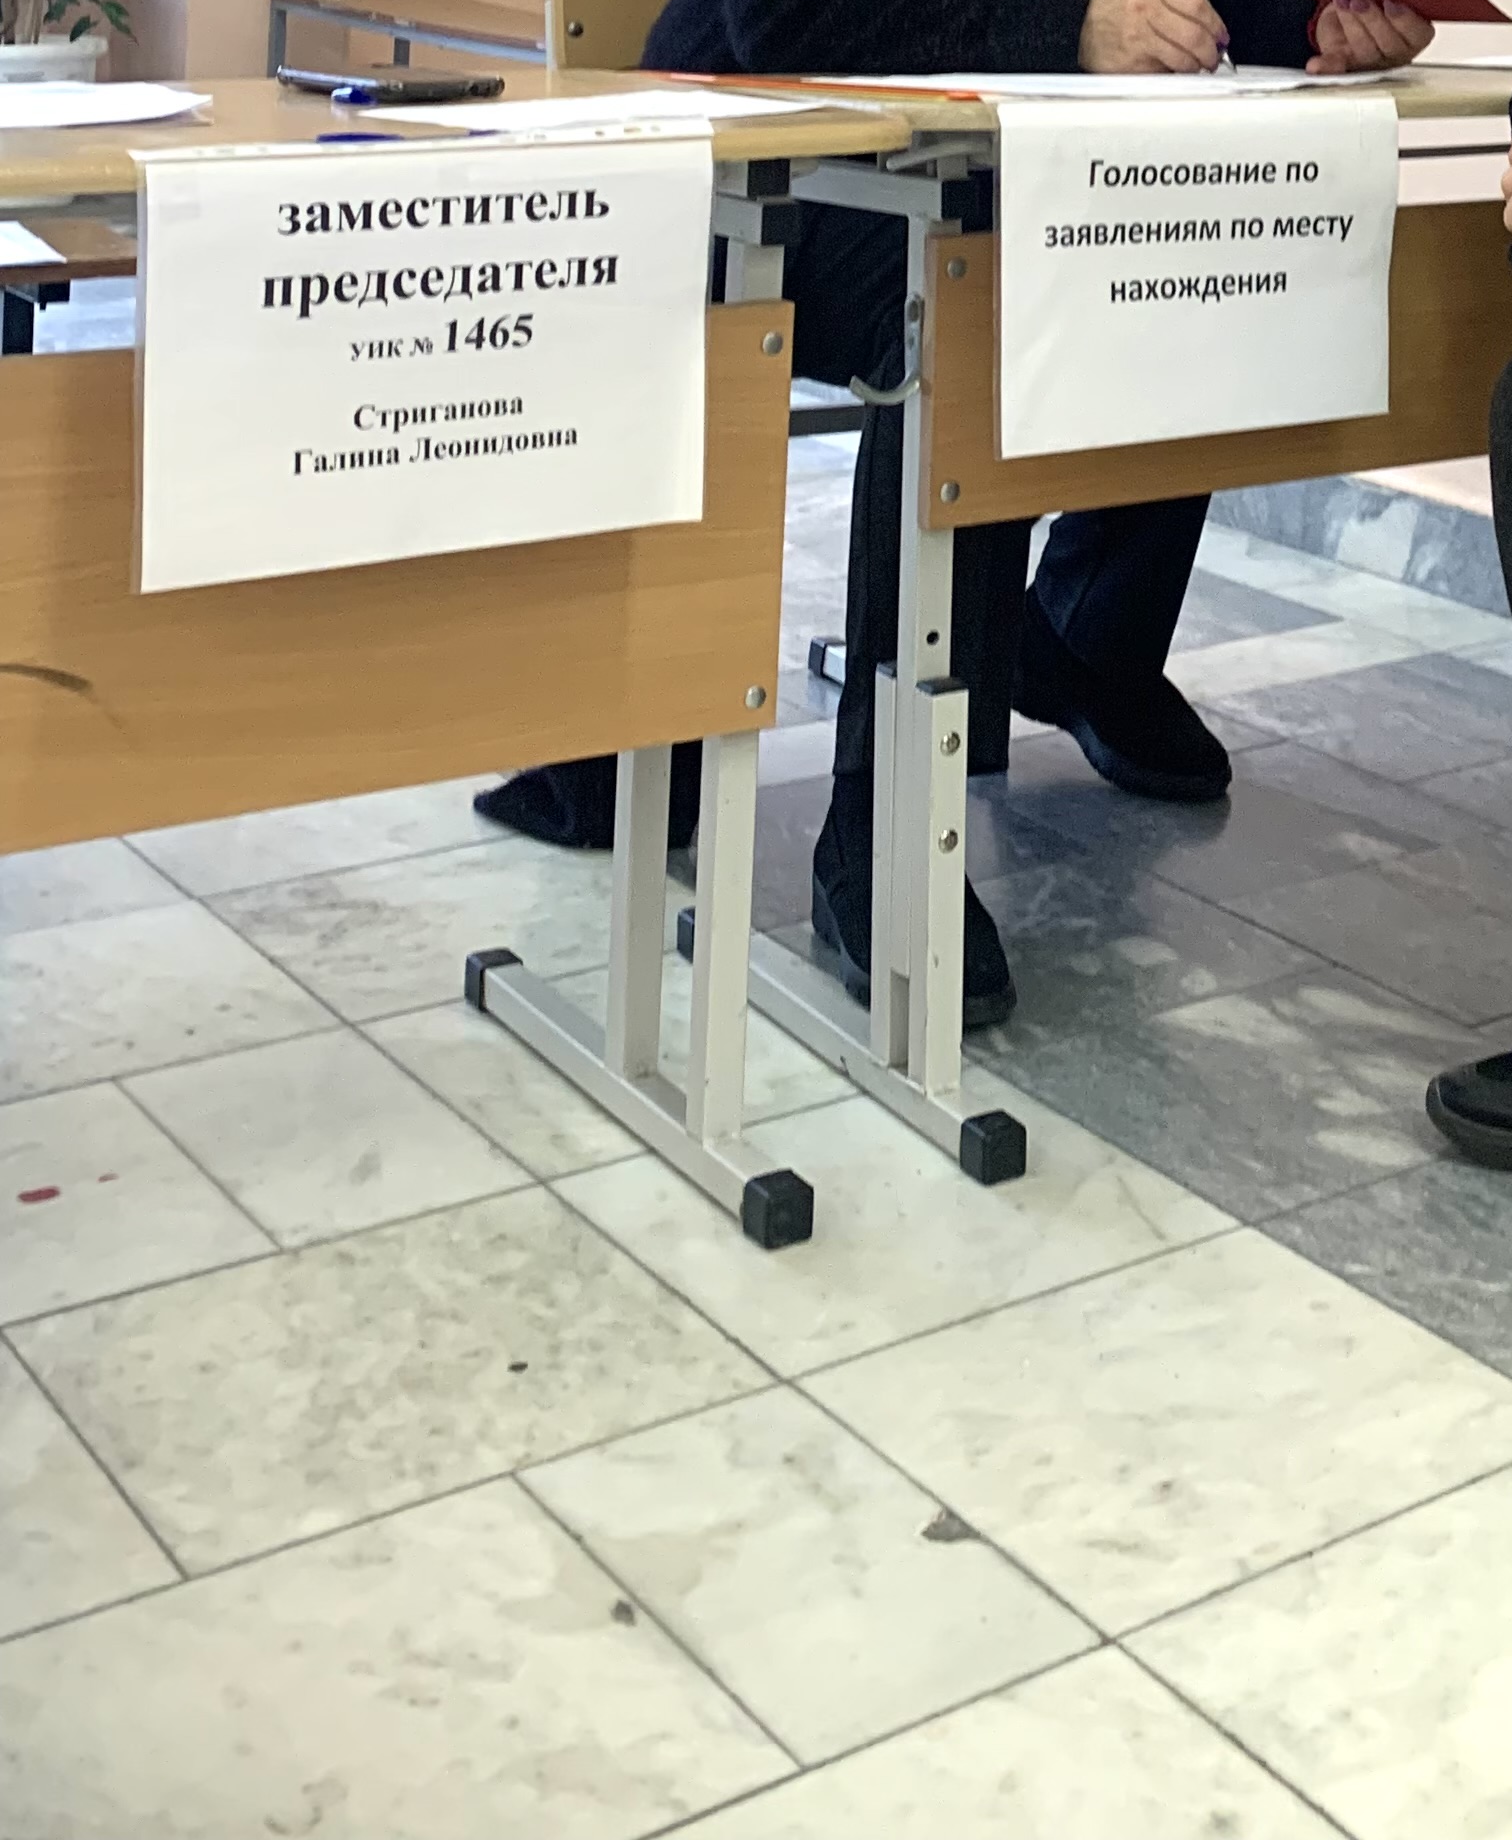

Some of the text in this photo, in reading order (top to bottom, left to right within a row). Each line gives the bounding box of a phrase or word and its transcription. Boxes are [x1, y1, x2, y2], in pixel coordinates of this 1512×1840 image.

[1089, 159, 1319, 188] Голосование по
[278, 189, 610, 236] заместитель
[1044, 214, 1354, 248] заявлениям по месту
[263, 255, 619, 318] председателя
[1110, 271, 1287, 304] нахождения
[445, 312, 534, 353] 1465
[353, 396, 523, 433] Стриганова
[294, 428, 578, 475] Галина Леонидовна
